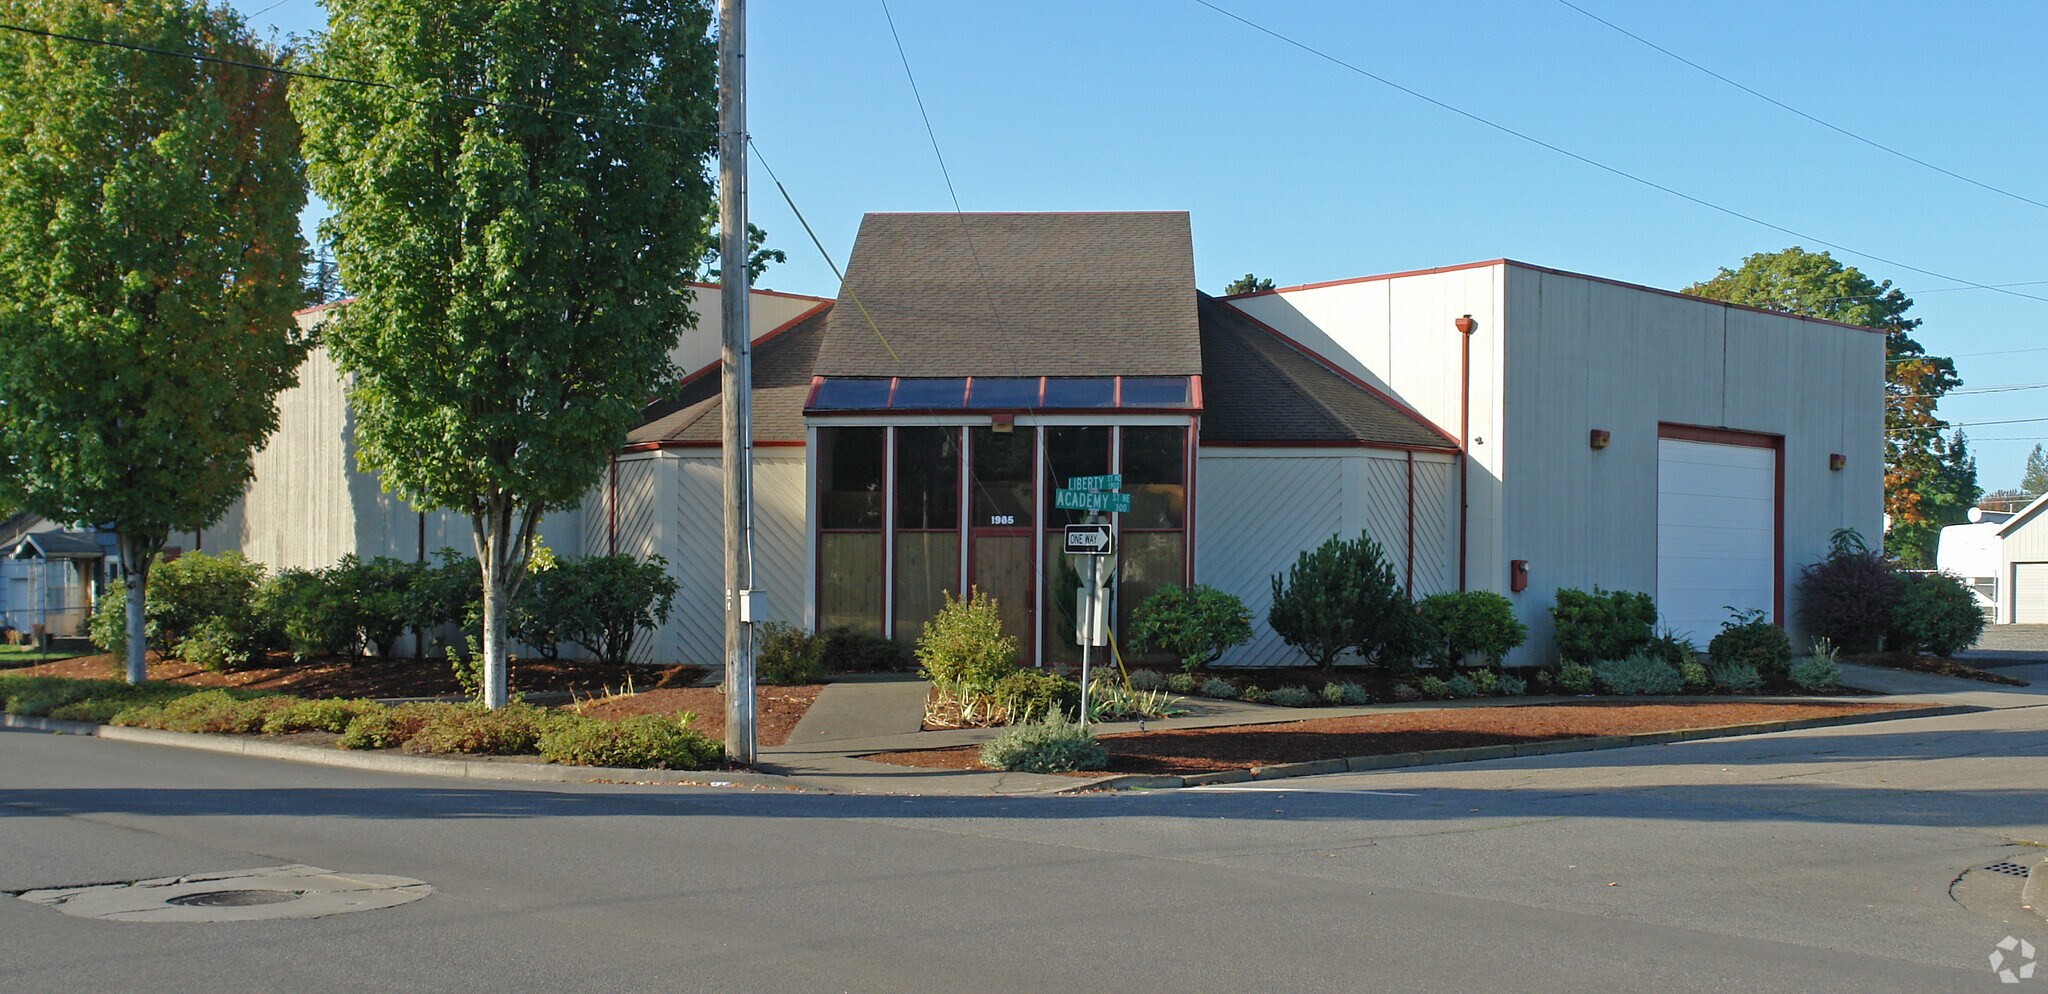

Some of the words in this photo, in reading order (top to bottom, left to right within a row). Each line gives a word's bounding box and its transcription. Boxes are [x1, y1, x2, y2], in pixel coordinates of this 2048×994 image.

[1068, 476, 1105, 491] LIBERTY
[1057, 491, 1109, 509] ACADEMY
[1112, 494, 1120, 502] ST
[1122, 495, 1130, 503] NE
[1115, 503, 1127, 512] 300
[991, 515, 1014, 525] 1985
[1070, 534, 1083, 544] ONE
[1084, 534, 1097, 544] WAY
